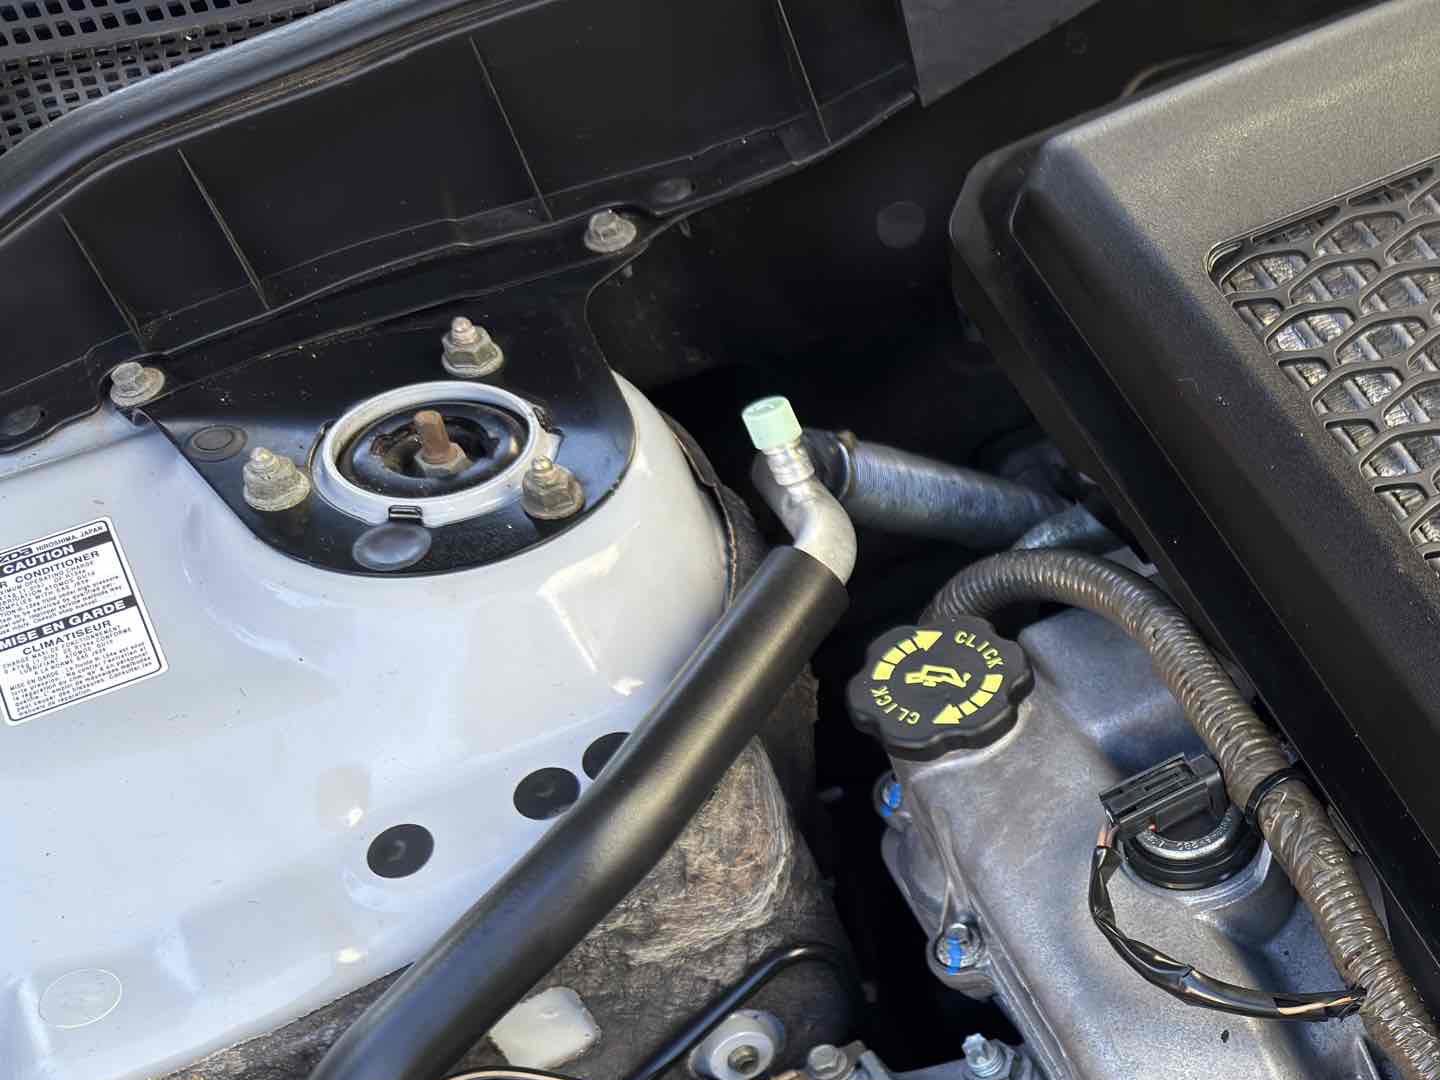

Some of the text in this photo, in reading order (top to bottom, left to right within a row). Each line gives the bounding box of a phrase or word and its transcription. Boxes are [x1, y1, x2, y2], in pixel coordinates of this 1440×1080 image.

[79, 525, 104, 536] JAPAN
[3, 543, 75, 575] CAUTION
[15, 549, 99, 584] CONDITIONER
[1, 599, 127, 650] MISE EN GARDE
[22, 619, 112, 655] CLIMATISEUR
[954, 631, 1004, 669] CLICK
[871, 686, 920, 725] CLICK
